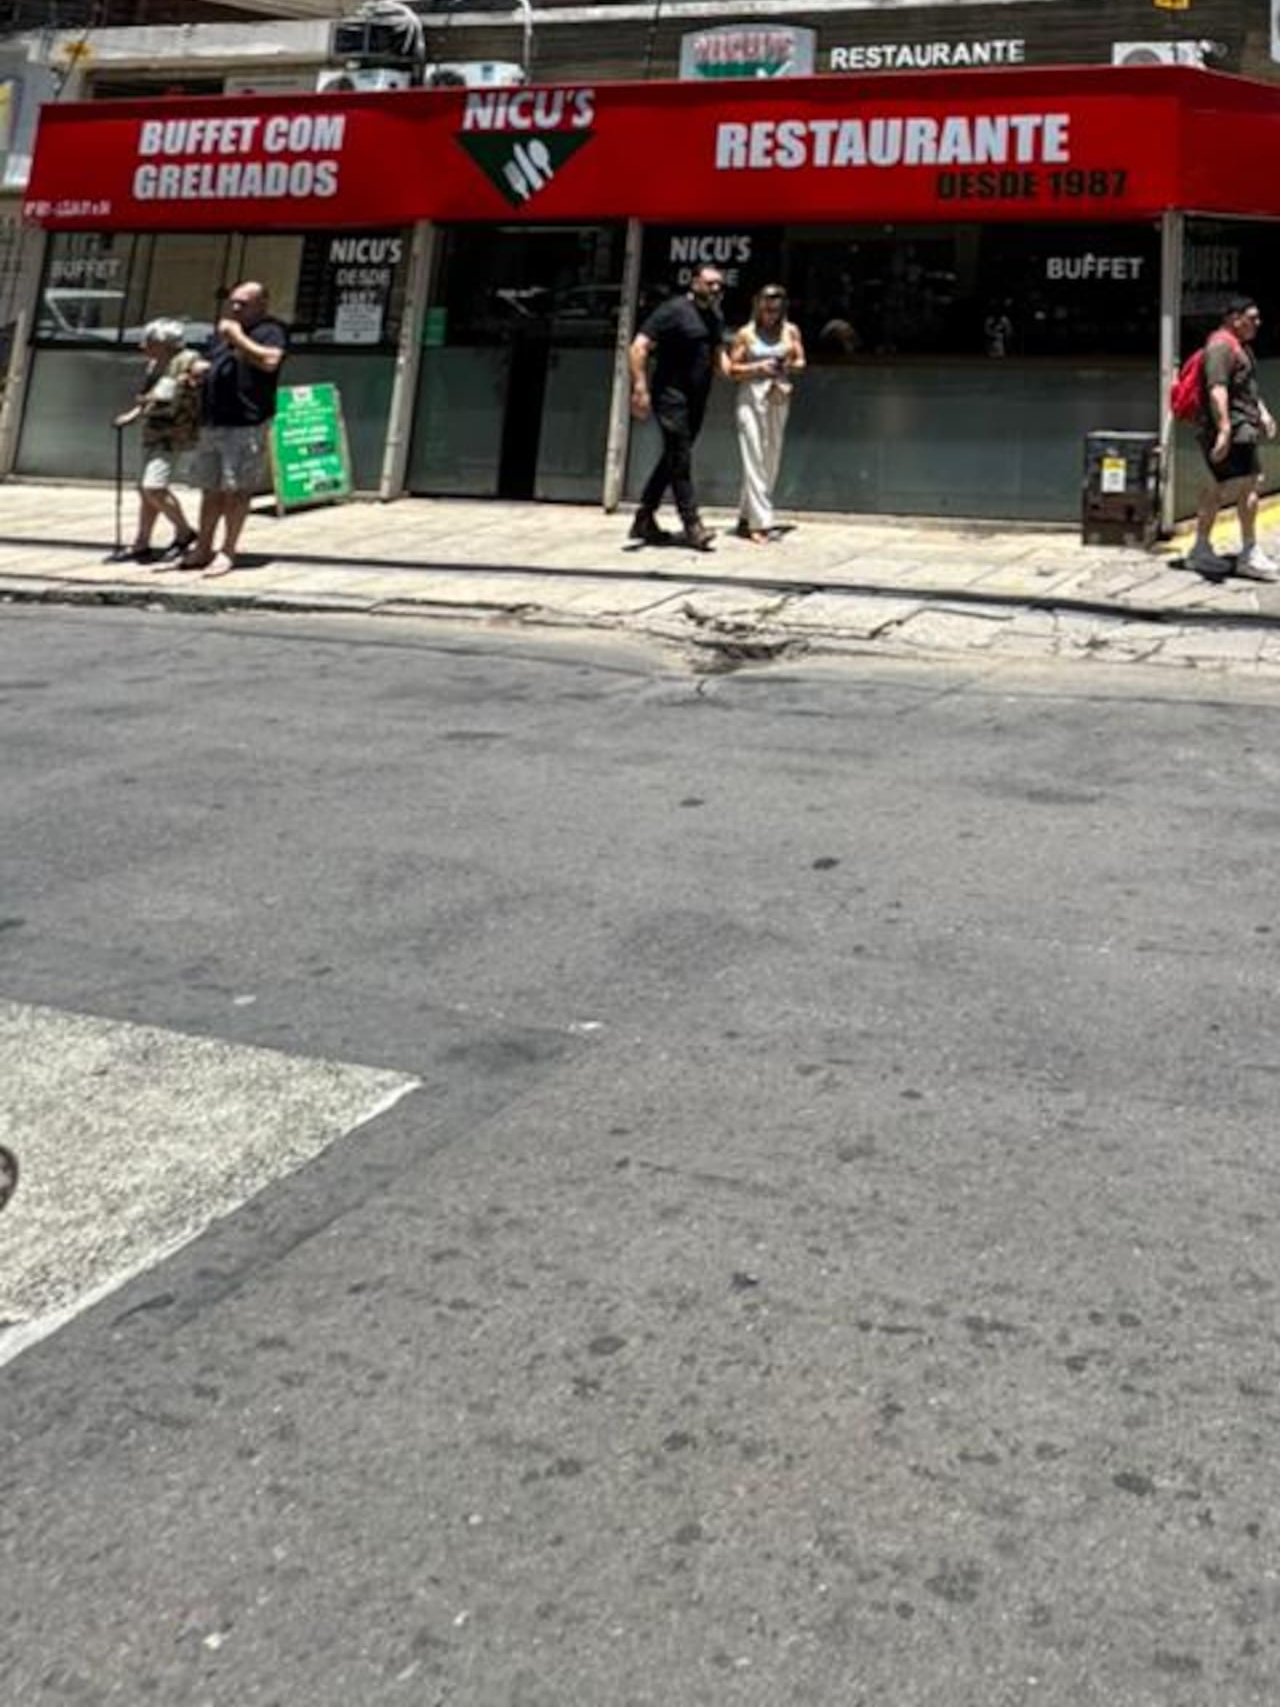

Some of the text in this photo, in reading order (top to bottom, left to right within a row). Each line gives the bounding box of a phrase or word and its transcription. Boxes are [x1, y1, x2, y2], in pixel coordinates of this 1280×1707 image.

[830, 39, 1025, 70] RESTAURANTE
[462, 89, 596, 130] NICU'S
[137, 114, 346, 157] BUFFET COM
[714, 113, 1071, 170] RESTAURANTE
[132, 159, 339, 201] GRELHADOS
[936, 168, 1128, 201] DESDE 1987
[329, 238, 403, 264] NICU'S
[669, 234, 752, 263] NICU'S
[1046, 255, 1144, 280] BUFFET
